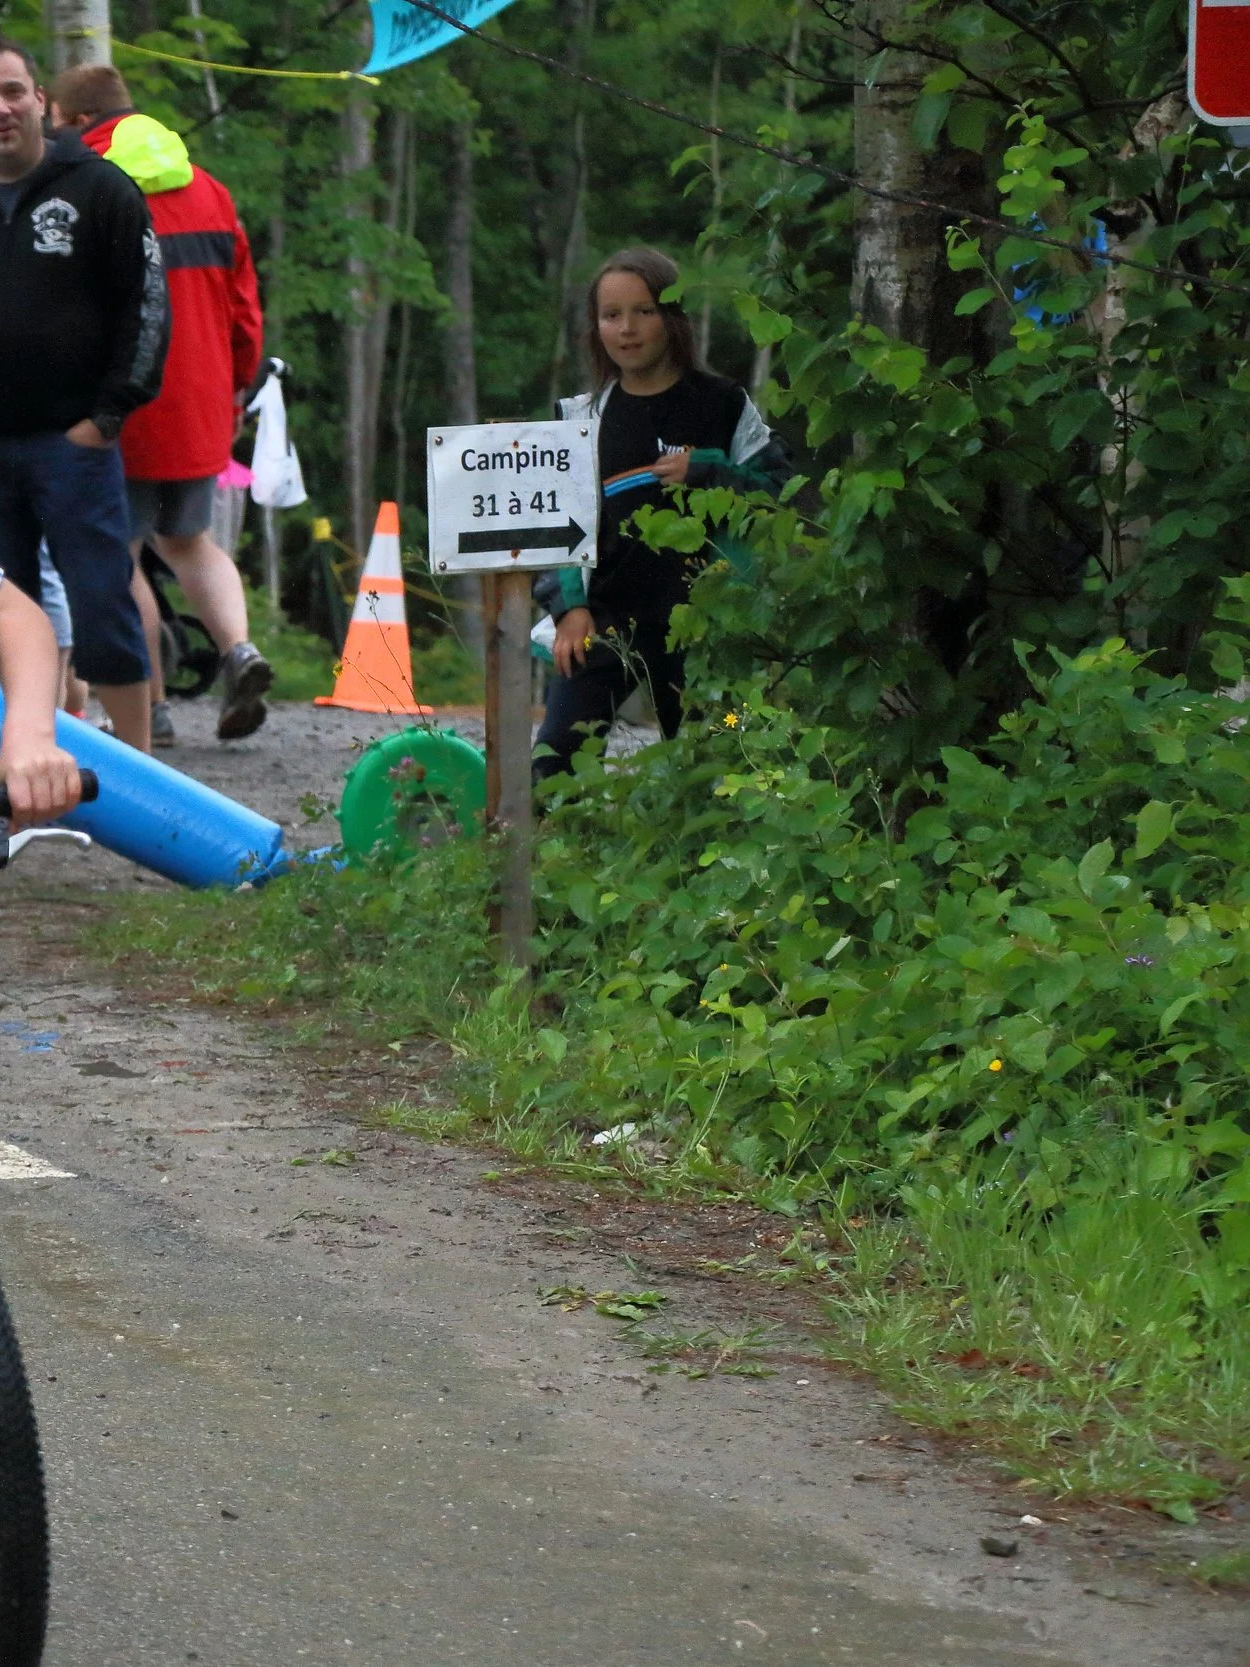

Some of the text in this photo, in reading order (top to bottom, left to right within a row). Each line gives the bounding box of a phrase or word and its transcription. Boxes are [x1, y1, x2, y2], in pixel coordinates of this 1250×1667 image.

[461, 444, 570, 474] Camping
[472, 490, 560, 518] 31 à 41
